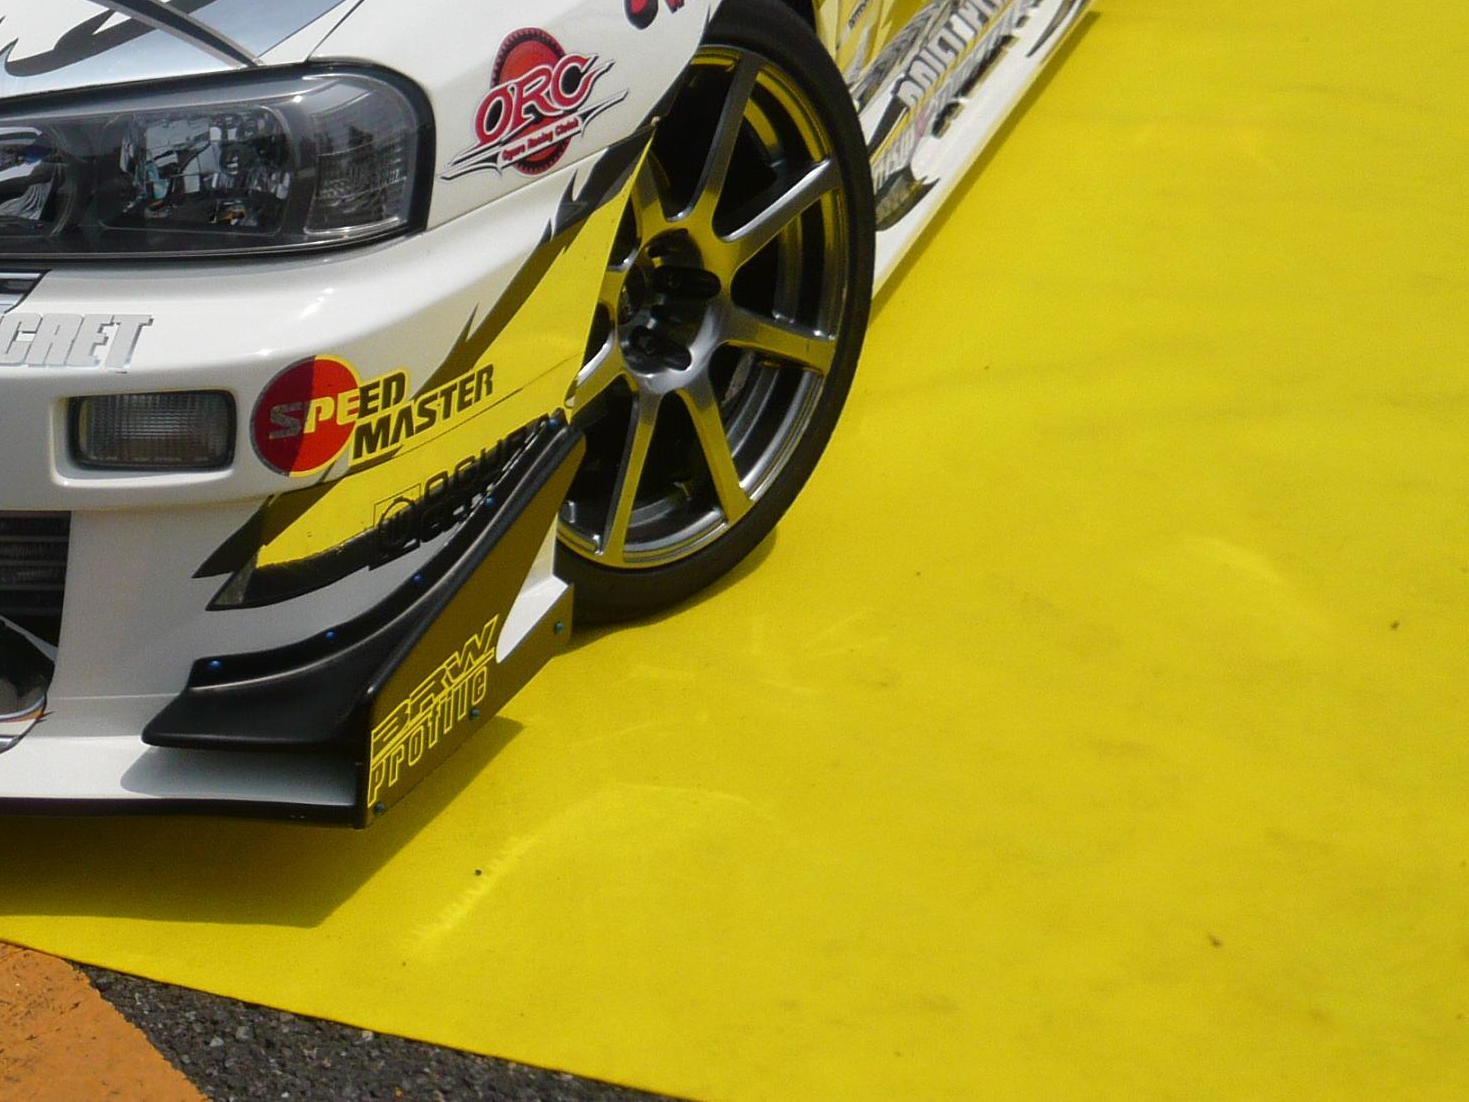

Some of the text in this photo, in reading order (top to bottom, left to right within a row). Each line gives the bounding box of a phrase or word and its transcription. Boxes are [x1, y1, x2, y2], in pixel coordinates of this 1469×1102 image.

[474, 53, 611, 146] ORC
[269, 371, 407, 440] SPEED
[352, 363, 495, 460] MASTER
